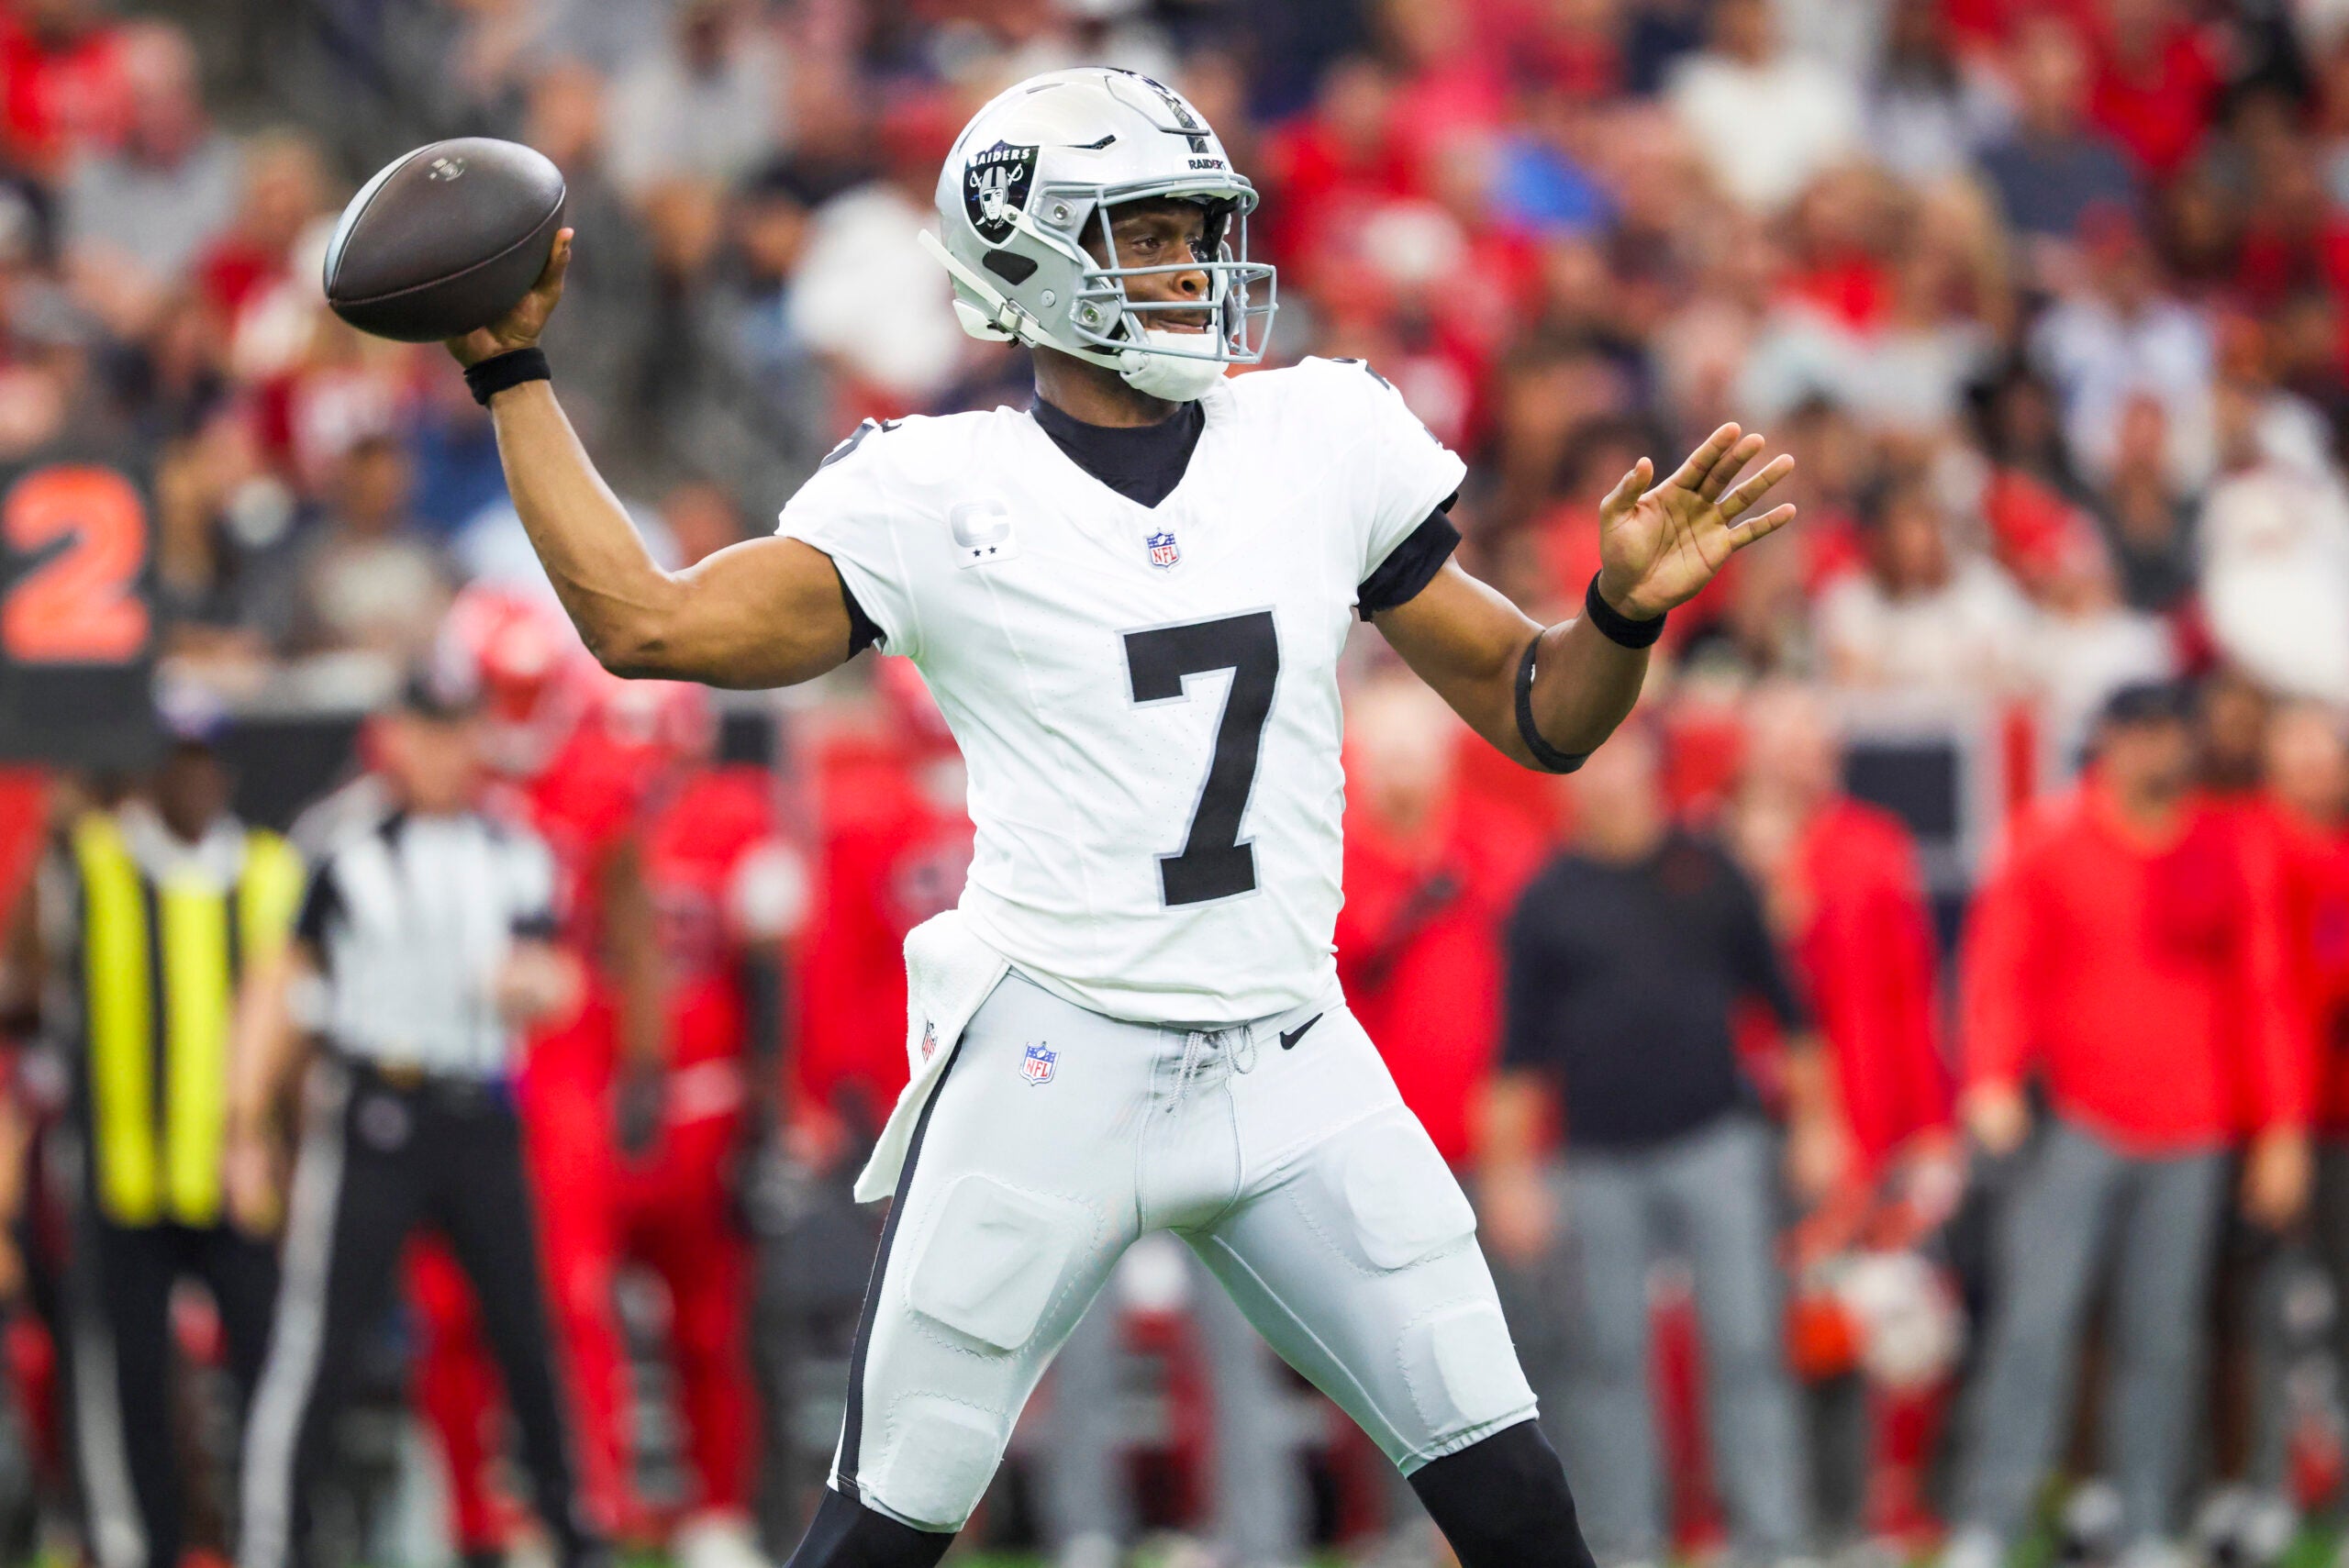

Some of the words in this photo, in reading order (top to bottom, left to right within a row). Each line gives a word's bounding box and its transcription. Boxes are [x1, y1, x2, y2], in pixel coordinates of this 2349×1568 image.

[3, 463, 150, 666] 2
[1152, 546, 1177, 563] NFL
[1116, 606, 1284, 910] 7
[1025, 1059, 1049, 1077] NFL
